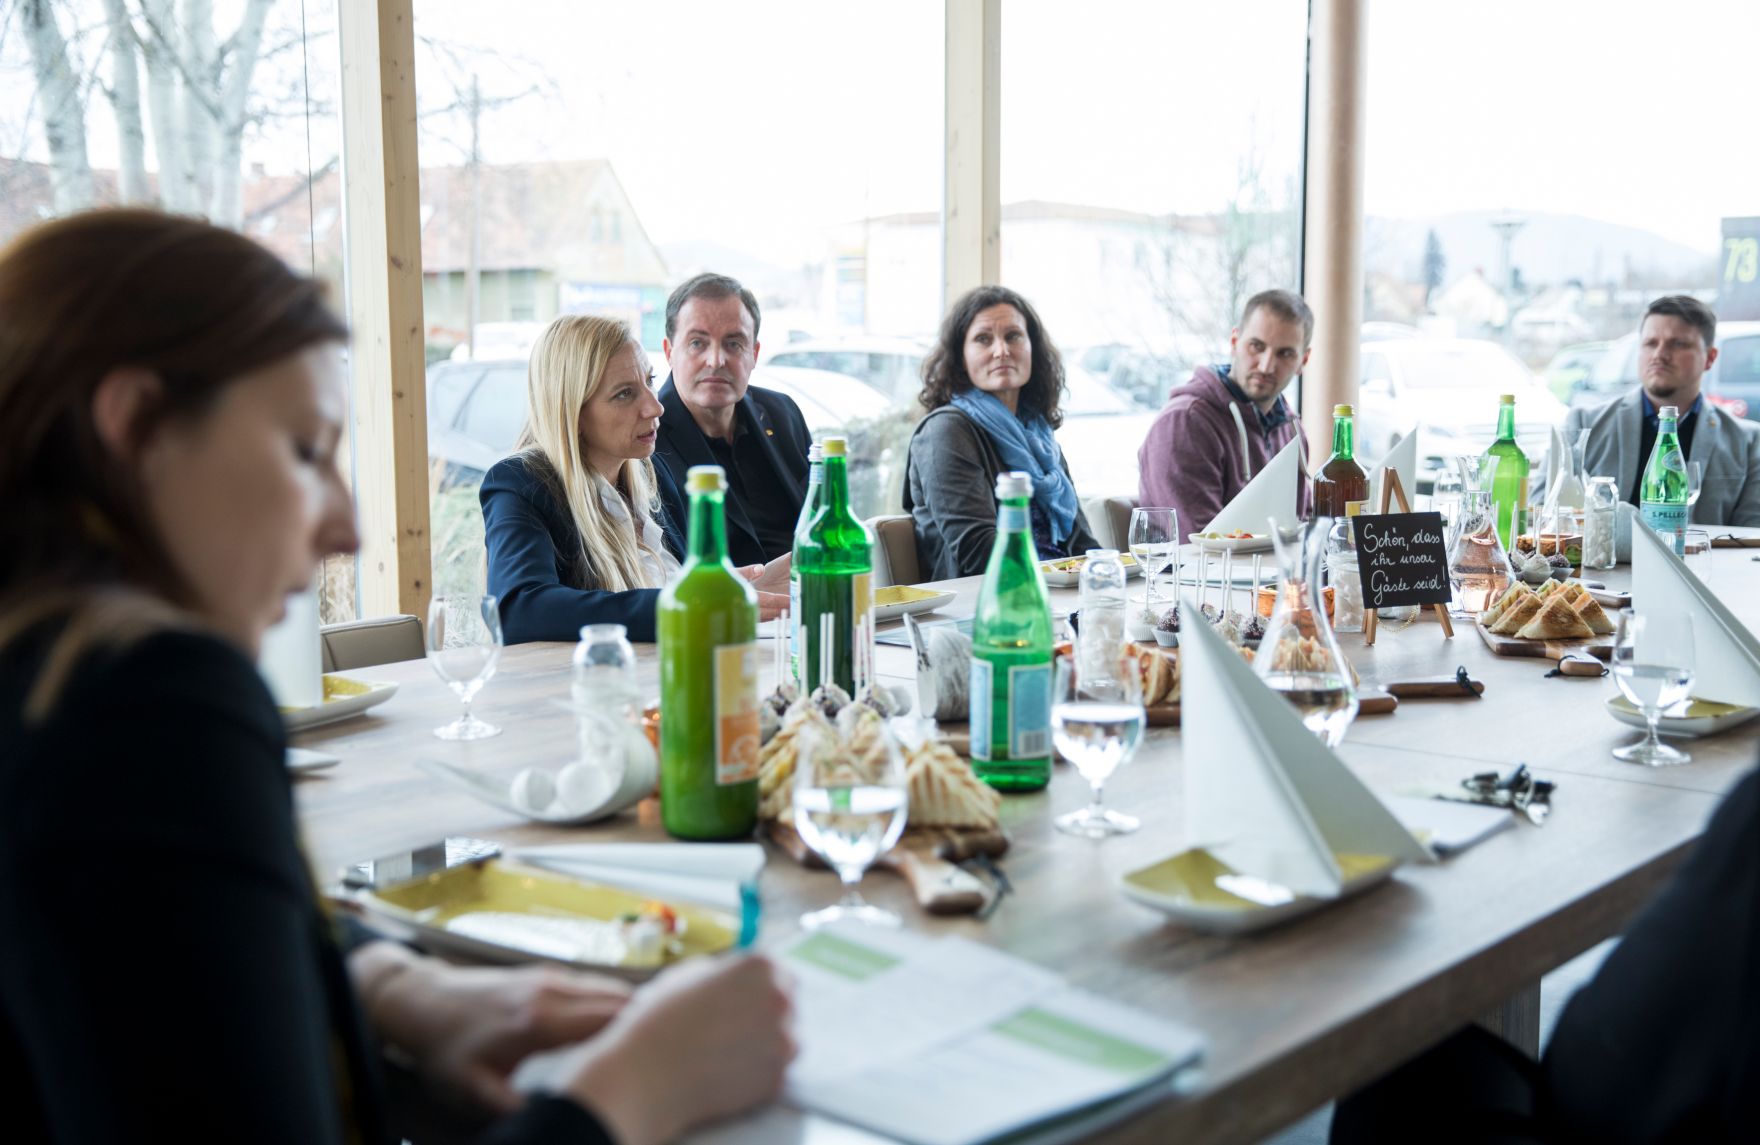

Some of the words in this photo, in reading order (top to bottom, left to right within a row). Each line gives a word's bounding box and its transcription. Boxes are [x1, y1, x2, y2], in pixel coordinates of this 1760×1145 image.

[1724, 238, 1757, 282] 73
[1363, 523, 1409, 553] Schön,
[1410, 529, 1440, 544] dass
[1371, 552, 1395, 566] ihr
[1371, 569, 1410, 605] Gäste
[1412, 565, 1446, 590] seid!
